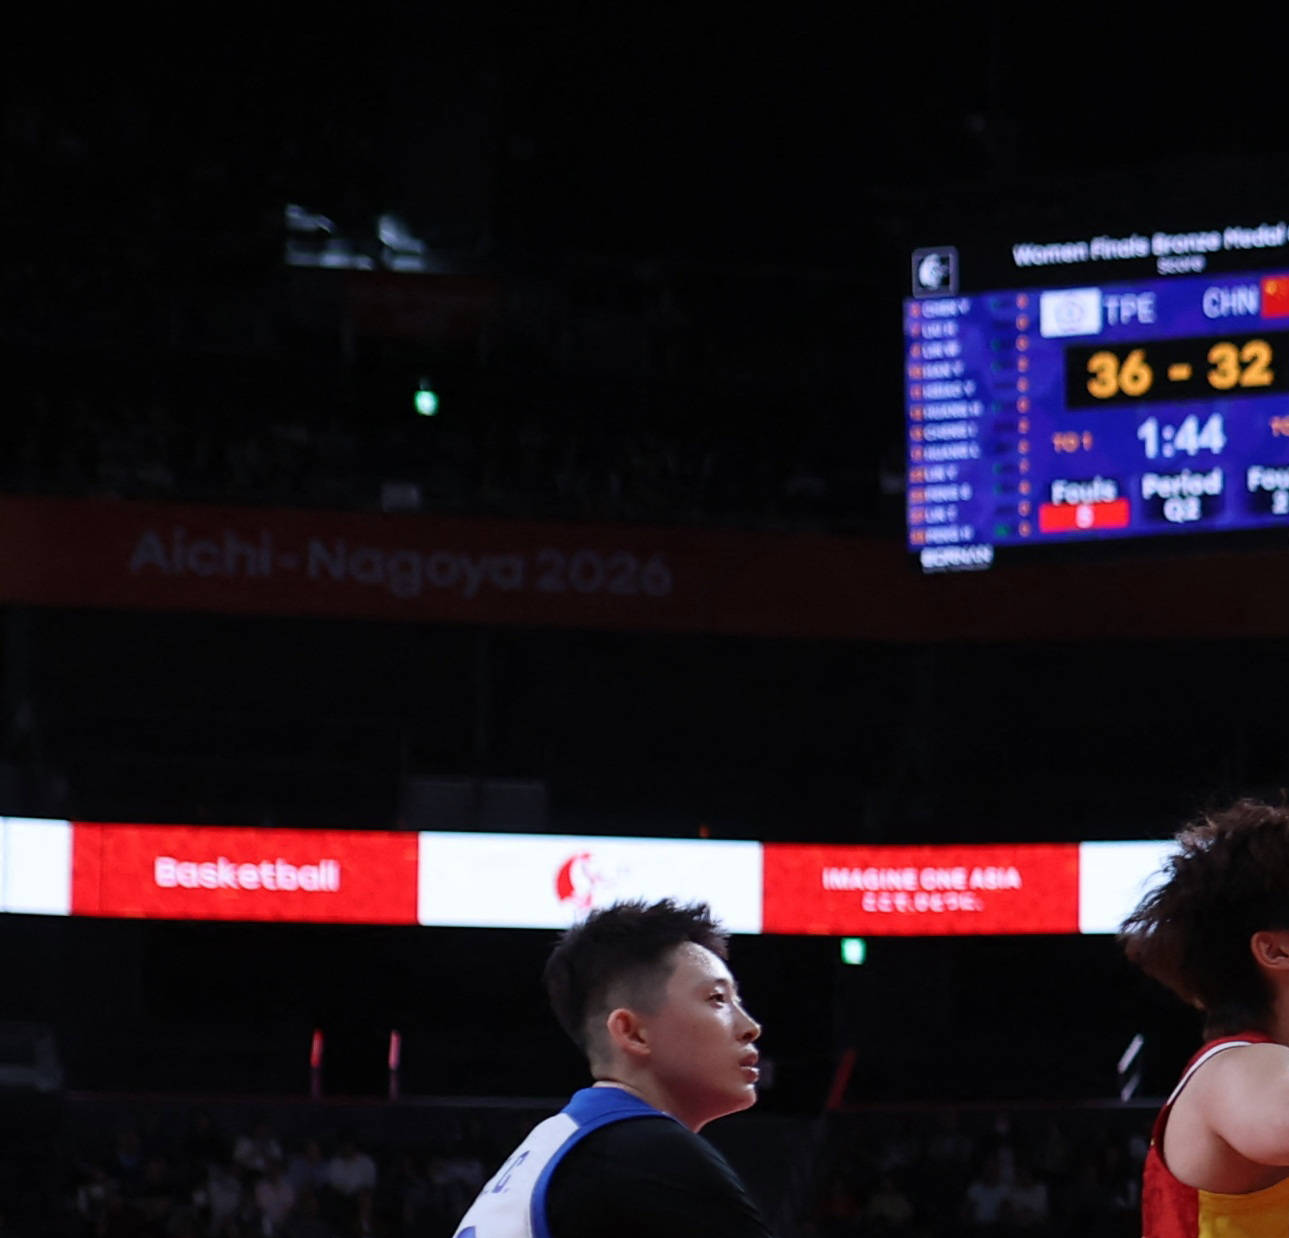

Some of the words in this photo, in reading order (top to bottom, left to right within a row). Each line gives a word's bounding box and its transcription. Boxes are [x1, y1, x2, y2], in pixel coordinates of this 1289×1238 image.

[1013, 240, 1088, 267] Women
[1090, 233, 1150, 260] Finals
[1152, 231, 1222, 256] Bronze
[1223, 223, 1287, 250] Medal
[1104, 291, 1156, 326] TPE
[1203, 283, 1260, 319] CHN
[1086, 350, 1154, 399] 36
[1207, 339, 1275, 390] 32
[1137, 412, 1227, 460] 1:44
[1051, 474, 1118, 506] Fouls
[1141, 466, 1223, 499] Period
[128, 525, 526, 600] Aichi-Nagoya
[534, 547, 675, 599] 2026
[153, 856, 341, 893] Basketball
[822, 866, 917, 891] IMAGINE
[919, 866, 967, 891] ONE
[969, 865, 1023, 890] ASIA
